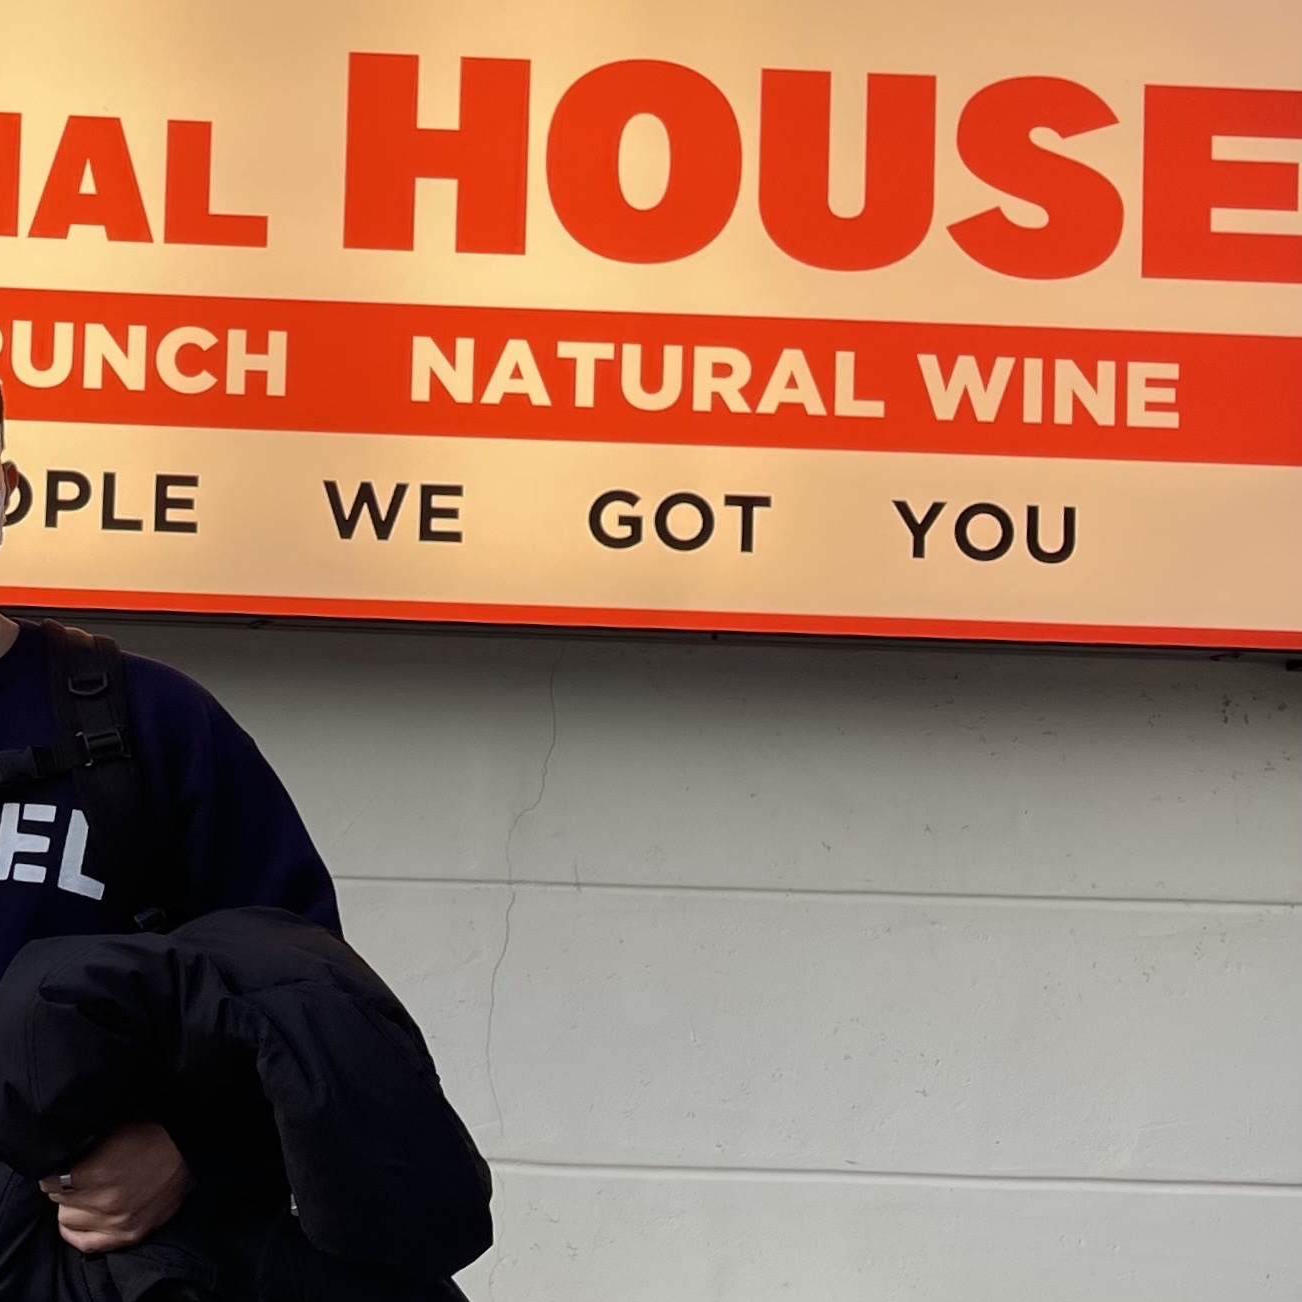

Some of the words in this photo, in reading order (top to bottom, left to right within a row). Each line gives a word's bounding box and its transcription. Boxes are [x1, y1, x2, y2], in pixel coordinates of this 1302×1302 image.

[343, 52, 1302, 283] HOUSE
[411, 336, 885, 417] NATURAL
[917, 353, 1179, 428] WINE
[3, 469, 199, 534] PLE
[323, 480, 463, 543] WE
[588, 489, 772, 553] GOT
[892, 500, 1076, 564] YOU
